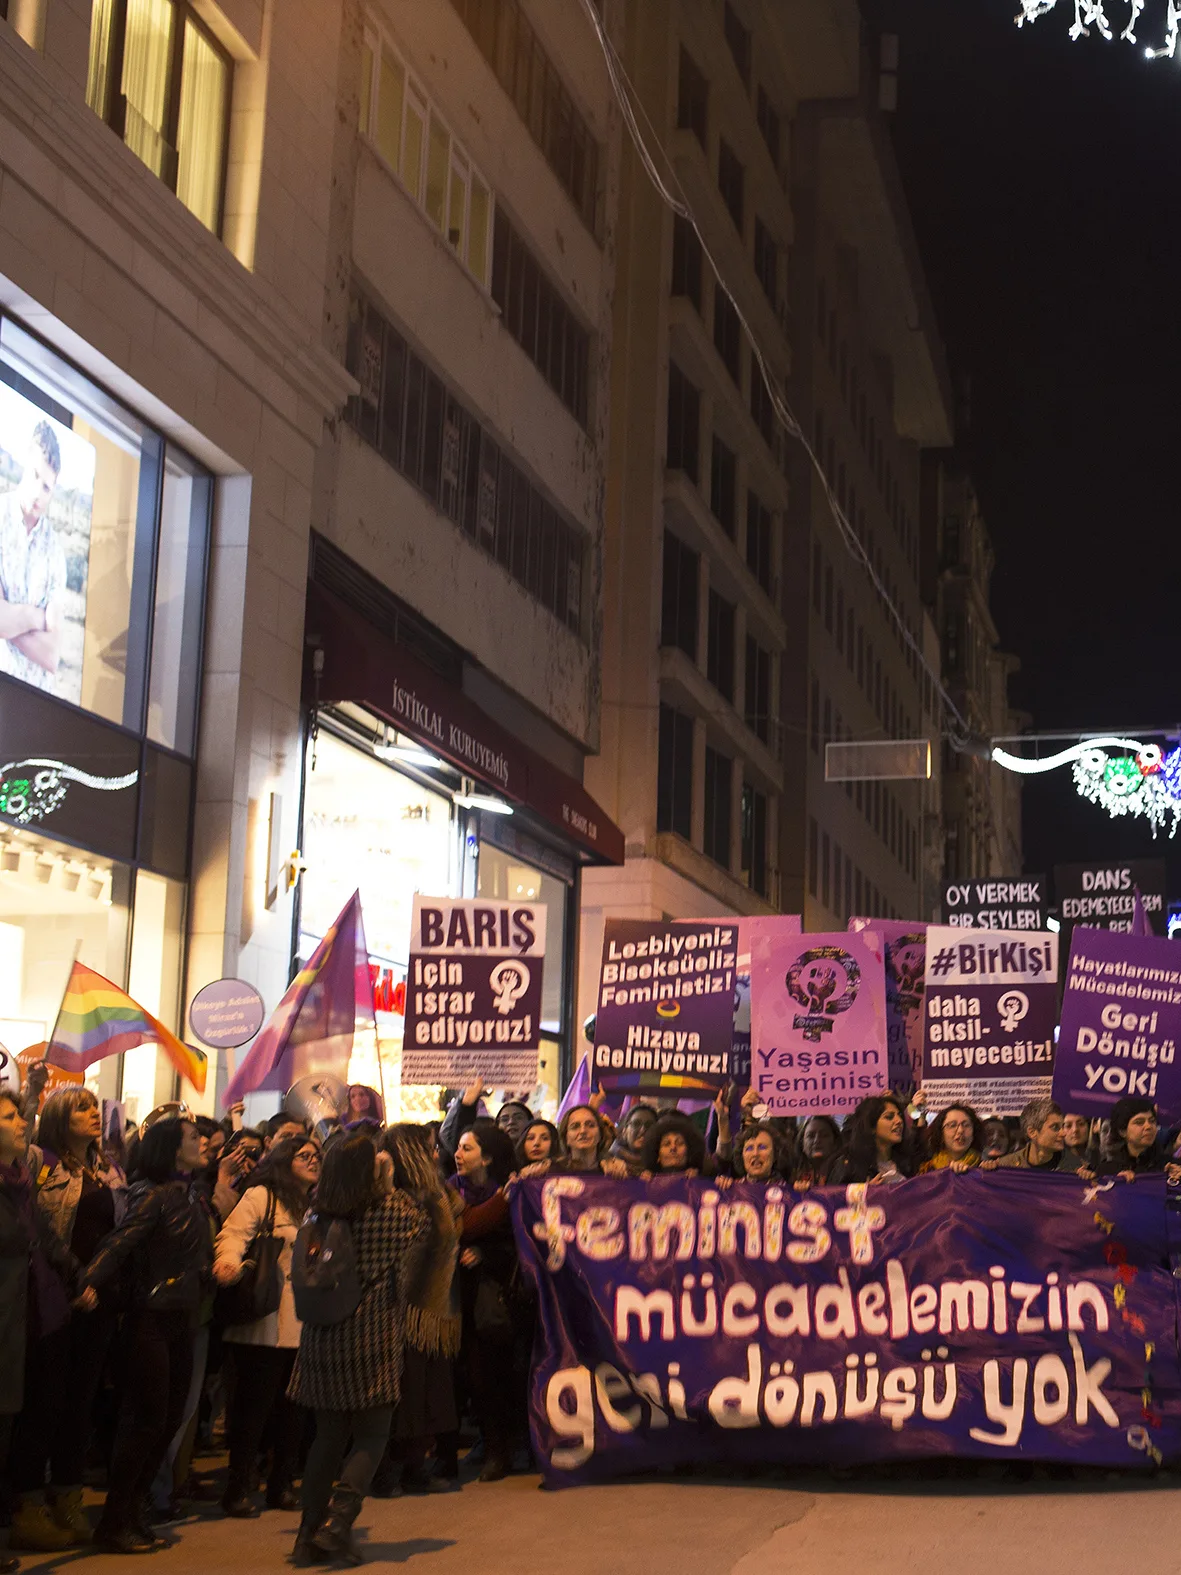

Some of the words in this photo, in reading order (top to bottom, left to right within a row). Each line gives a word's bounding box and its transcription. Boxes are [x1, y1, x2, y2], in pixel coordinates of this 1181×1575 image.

[393, 678, 445, 741] İSTİKLAL
[449, 723, 509, 788] KURUYEMİŞ
[946, 885, 970, 906] OY
[976, 882, 1040, 905] VERMEK
[1082, 869, 1131, 891] DANS
[1062, 895, 1162, 918] EDEMEYECESEM
[420, 908, 536, 955] BARIŞ
[608, 926, 733, 961] Lezbiyeniz
[414, 958, 463, 989] için
[602, 949, 735, 985] Biseksüeliz
[930, 941, 1052, 977] #BirKişi
[415, 991, 476, 1015] ısrar
[601, 970, 732, 1008] Feministiz!
[928, 994, 981, 1019] daha
[1101, 1004, 1158, 1034] Geri
[415, 1014, 533, 1048] ediyoruz!
[929, 1018, 991, 1043] eksil-
[595, 1044, 730, 1075] Gelmiyoruz!
[757, 1047, 880, 1073] Yaşasın
[930, 1040, 1053, 1069] meyeceğiz!
[1076, 1027, 1176, 1068] Dönüşü
[758, 1071, 885, 1092] Feminist
[1083, 1063, 1159, 1097] YOK!
[531, 1175, 886, 1272] feminist
[615, 1259, 1110, 1343] mücadelemizin
[708, 1342, 958, 1430] dönüşü
[969, 1328, 1121, 1447] yok
